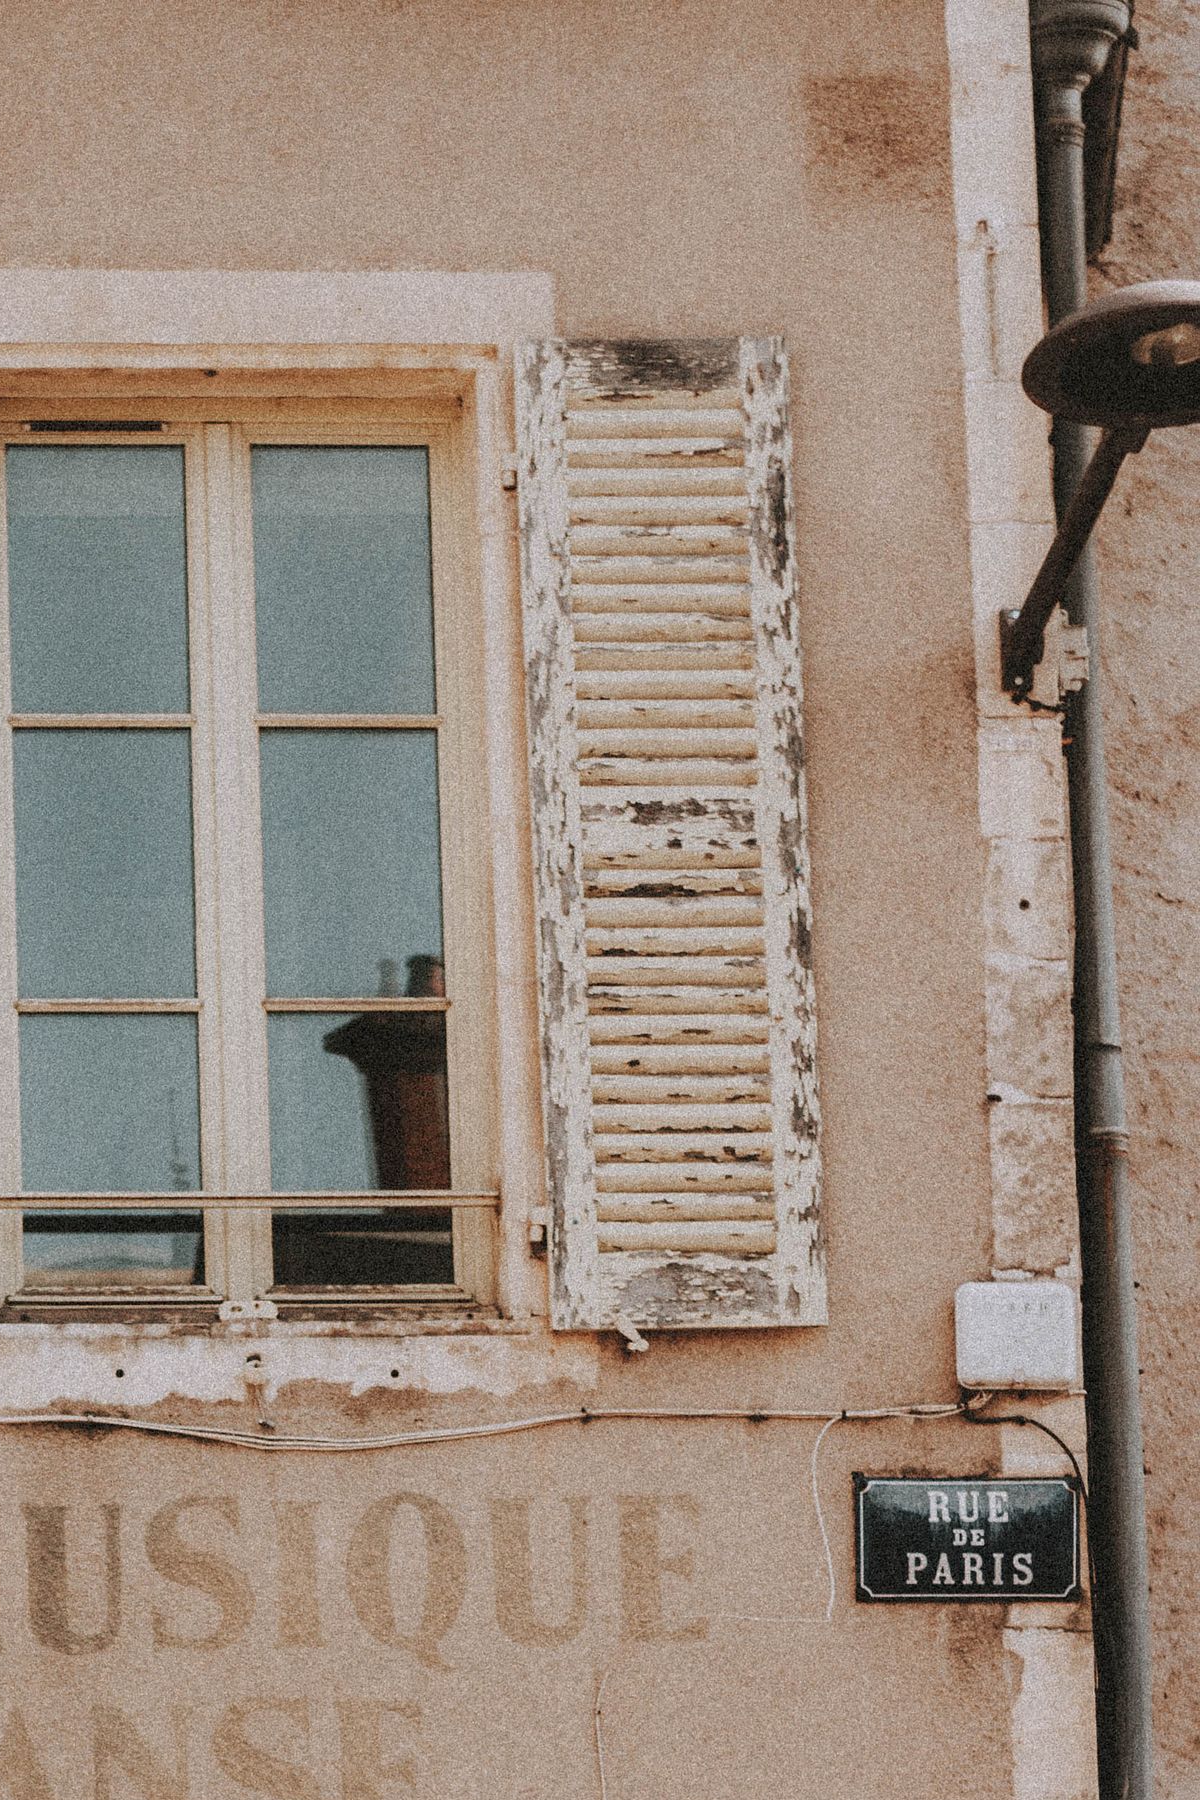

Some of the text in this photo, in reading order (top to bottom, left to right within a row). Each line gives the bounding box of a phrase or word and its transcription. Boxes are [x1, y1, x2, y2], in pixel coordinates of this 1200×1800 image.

[927, 1490, 1010, 1523] RUE
[952, 1528, 986, 1547] DE
[905, 1552, 1035, 1586] PARIS
